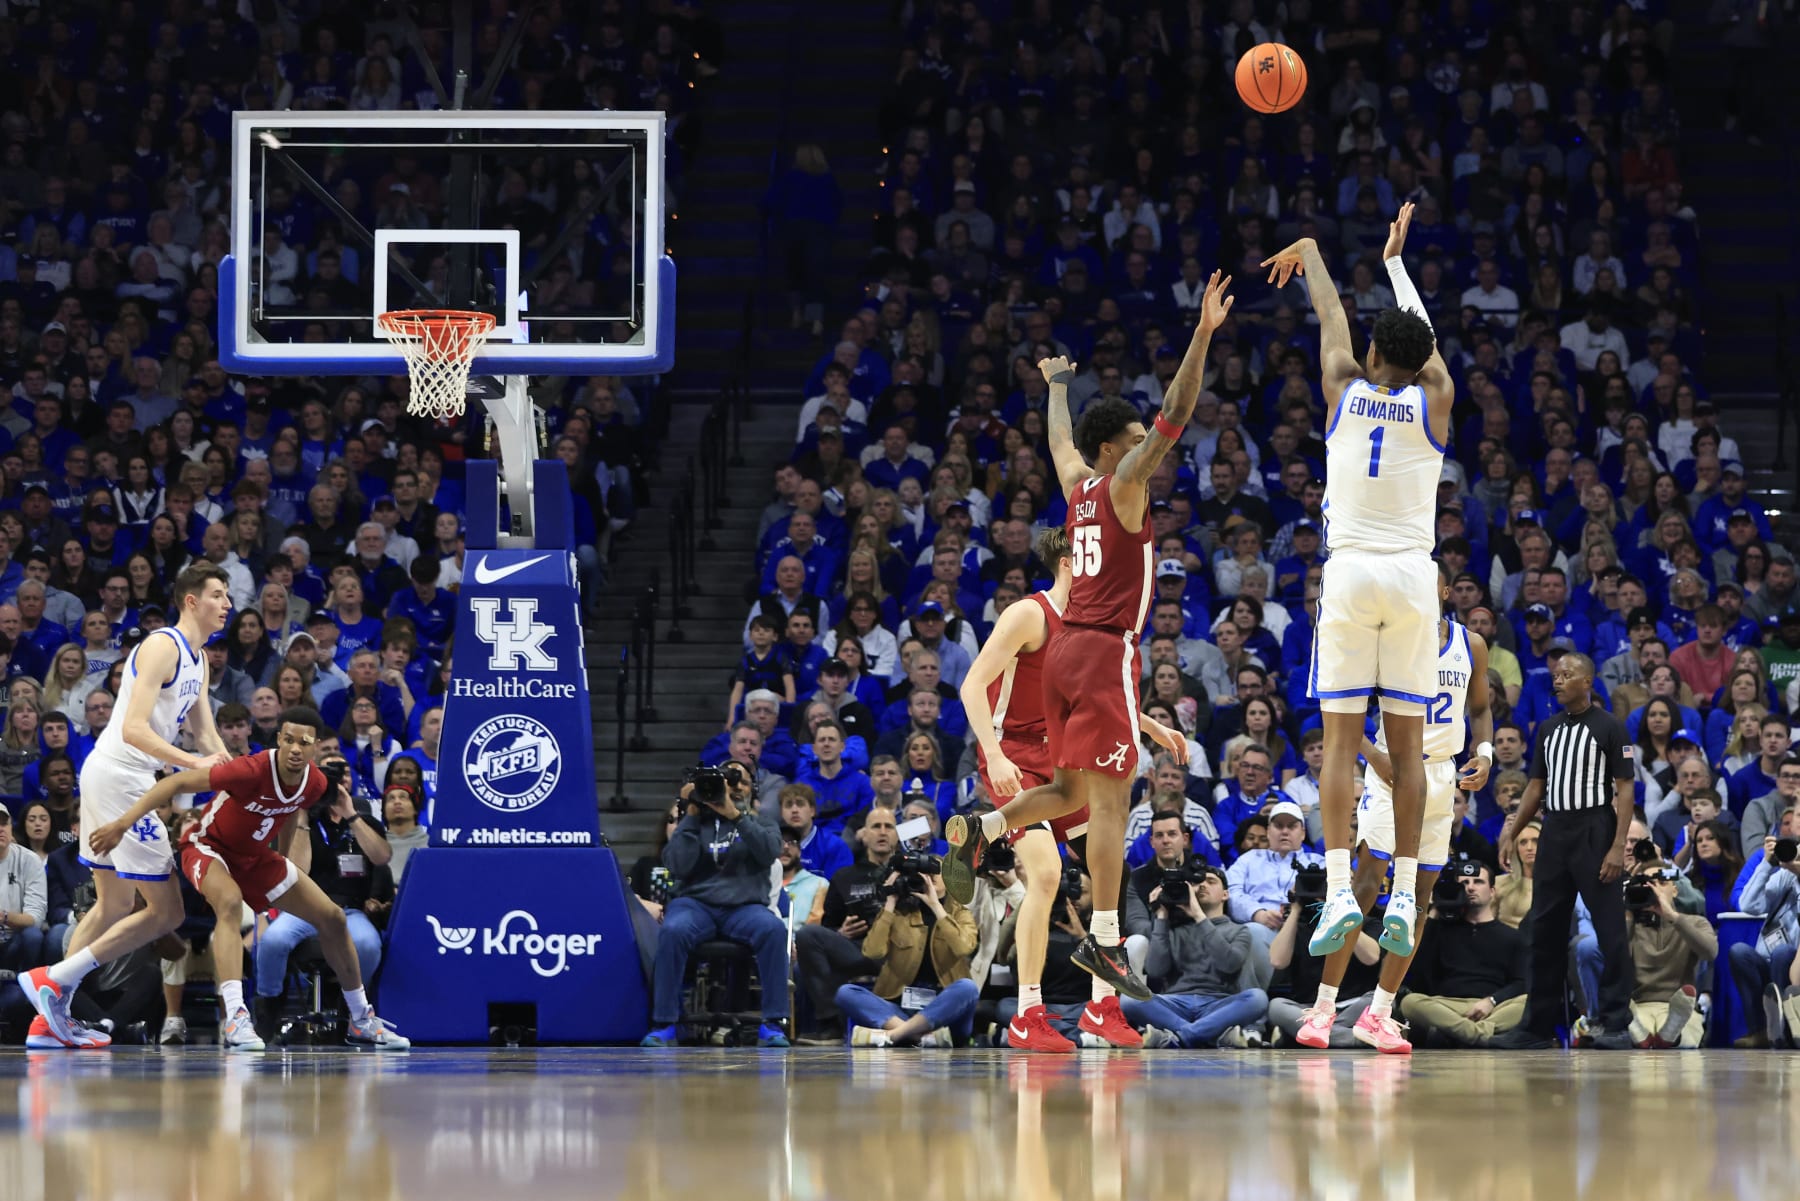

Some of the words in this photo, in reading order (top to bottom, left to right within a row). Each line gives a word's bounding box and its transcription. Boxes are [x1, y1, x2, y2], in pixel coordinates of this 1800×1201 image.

[1349, 396, 1414, 423] EDWARDS
[1369, 426, 1385, 477] 1
[1073, 525, 1102, 577] 55
[470, 597, 558, 672] UK
[453, 677, 577, 699] HealthCare
[1438, 670, 1467, 689] UCKY
[1426, 692, 1453, 724] 12
[472, 717, 545, 746] KENTUCKY
[490, 746, 538, 778] KFB
[472, 778, 505, 807] FARM
[507, 771, 555, 808] BUREAU
[251, 817, 275, 842] 3
[483, 909, 602, 978] Kroger
